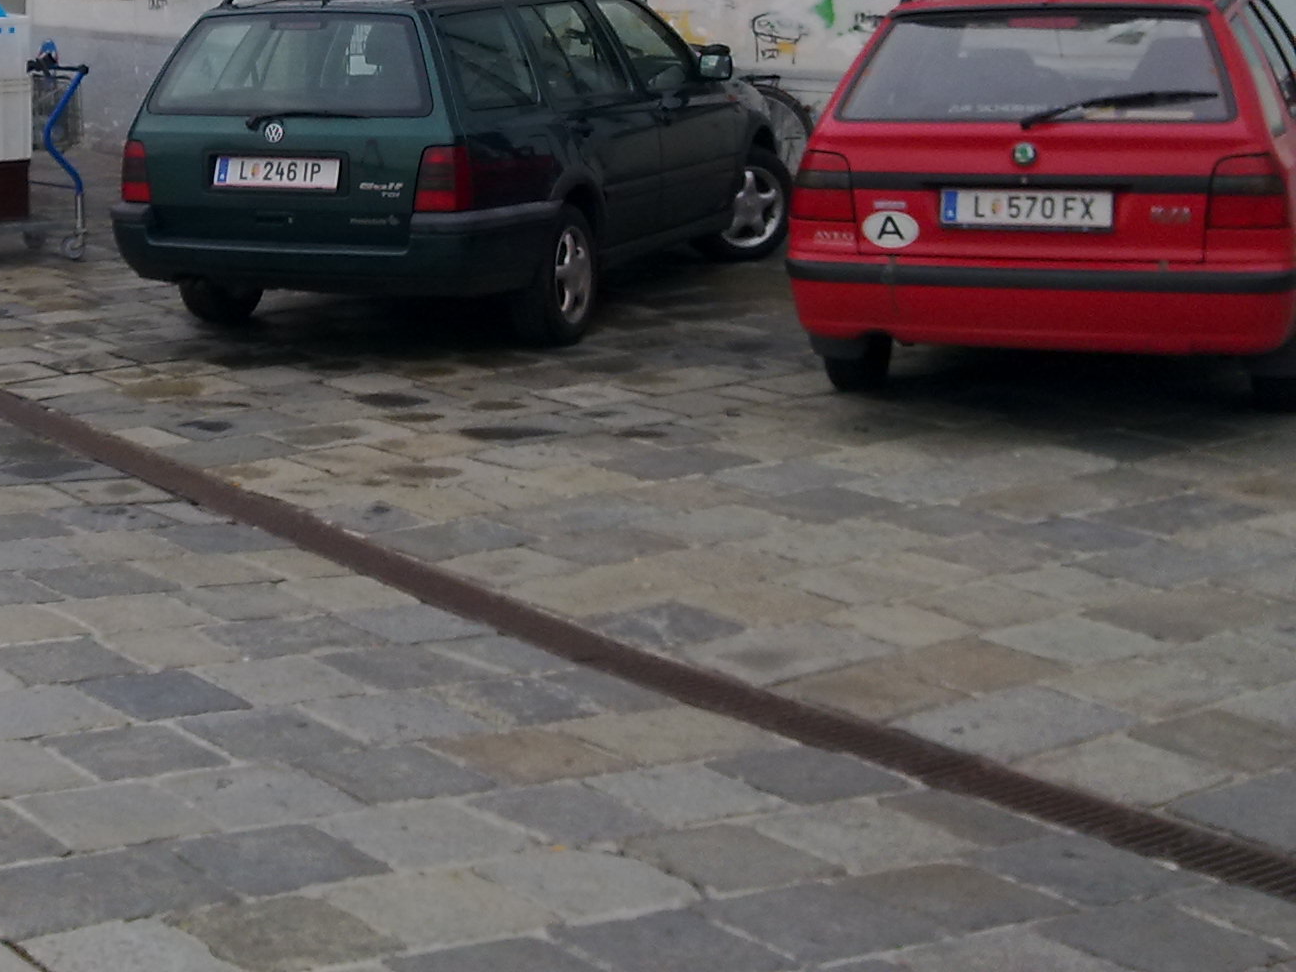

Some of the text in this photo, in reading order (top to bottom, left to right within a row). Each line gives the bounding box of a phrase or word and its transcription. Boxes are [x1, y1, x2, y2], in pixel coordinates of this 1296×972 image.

[239, 161, 322, 183] L 246 IP
[974, 195, 1095, 220] L 570 FX
[877, 215, 906, 241] A
